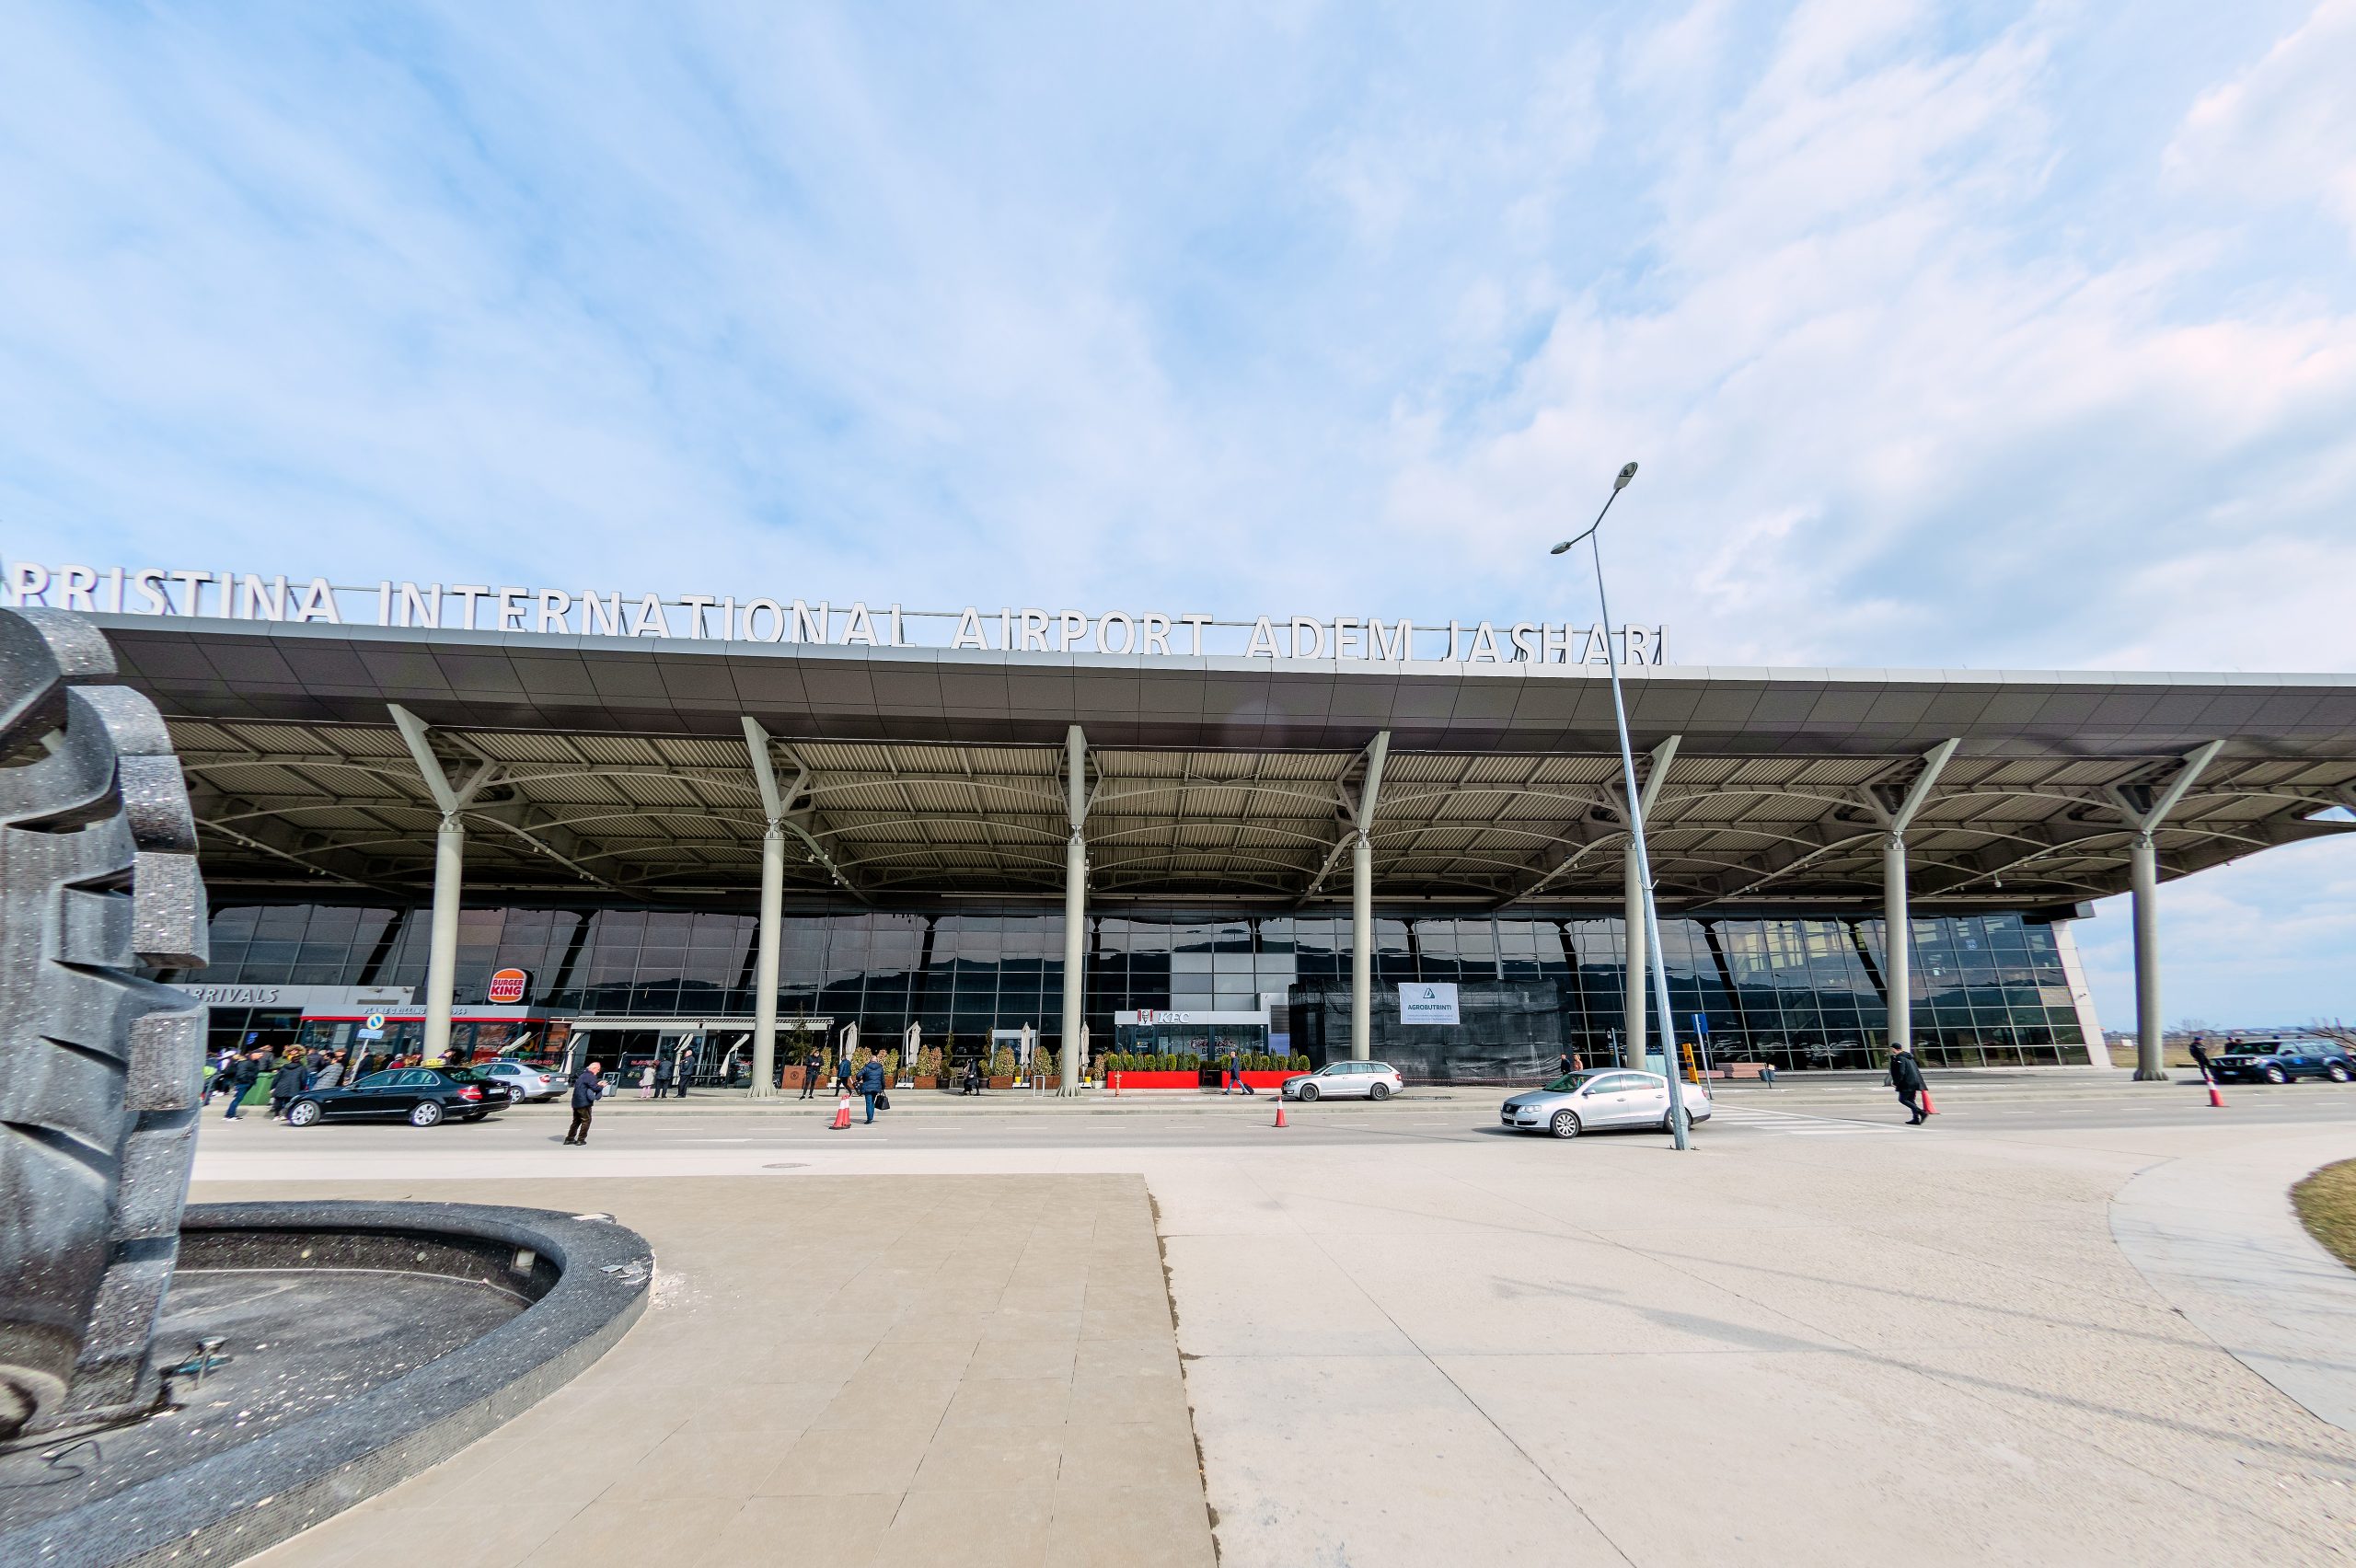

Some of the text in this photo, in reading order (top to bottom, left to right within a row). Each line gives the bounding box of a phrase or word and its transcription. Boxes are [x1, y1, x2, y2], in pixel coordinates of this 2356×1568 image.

[13, 561, 1670, 666] PRISTINA INTERNATIONAL AIRPORT ADEM JASHARI
[185, 988, 280, 1003] RRIVALS
[491, 986, 522, 995] KING
[1158, 1012, 1190, 1023] KFC
